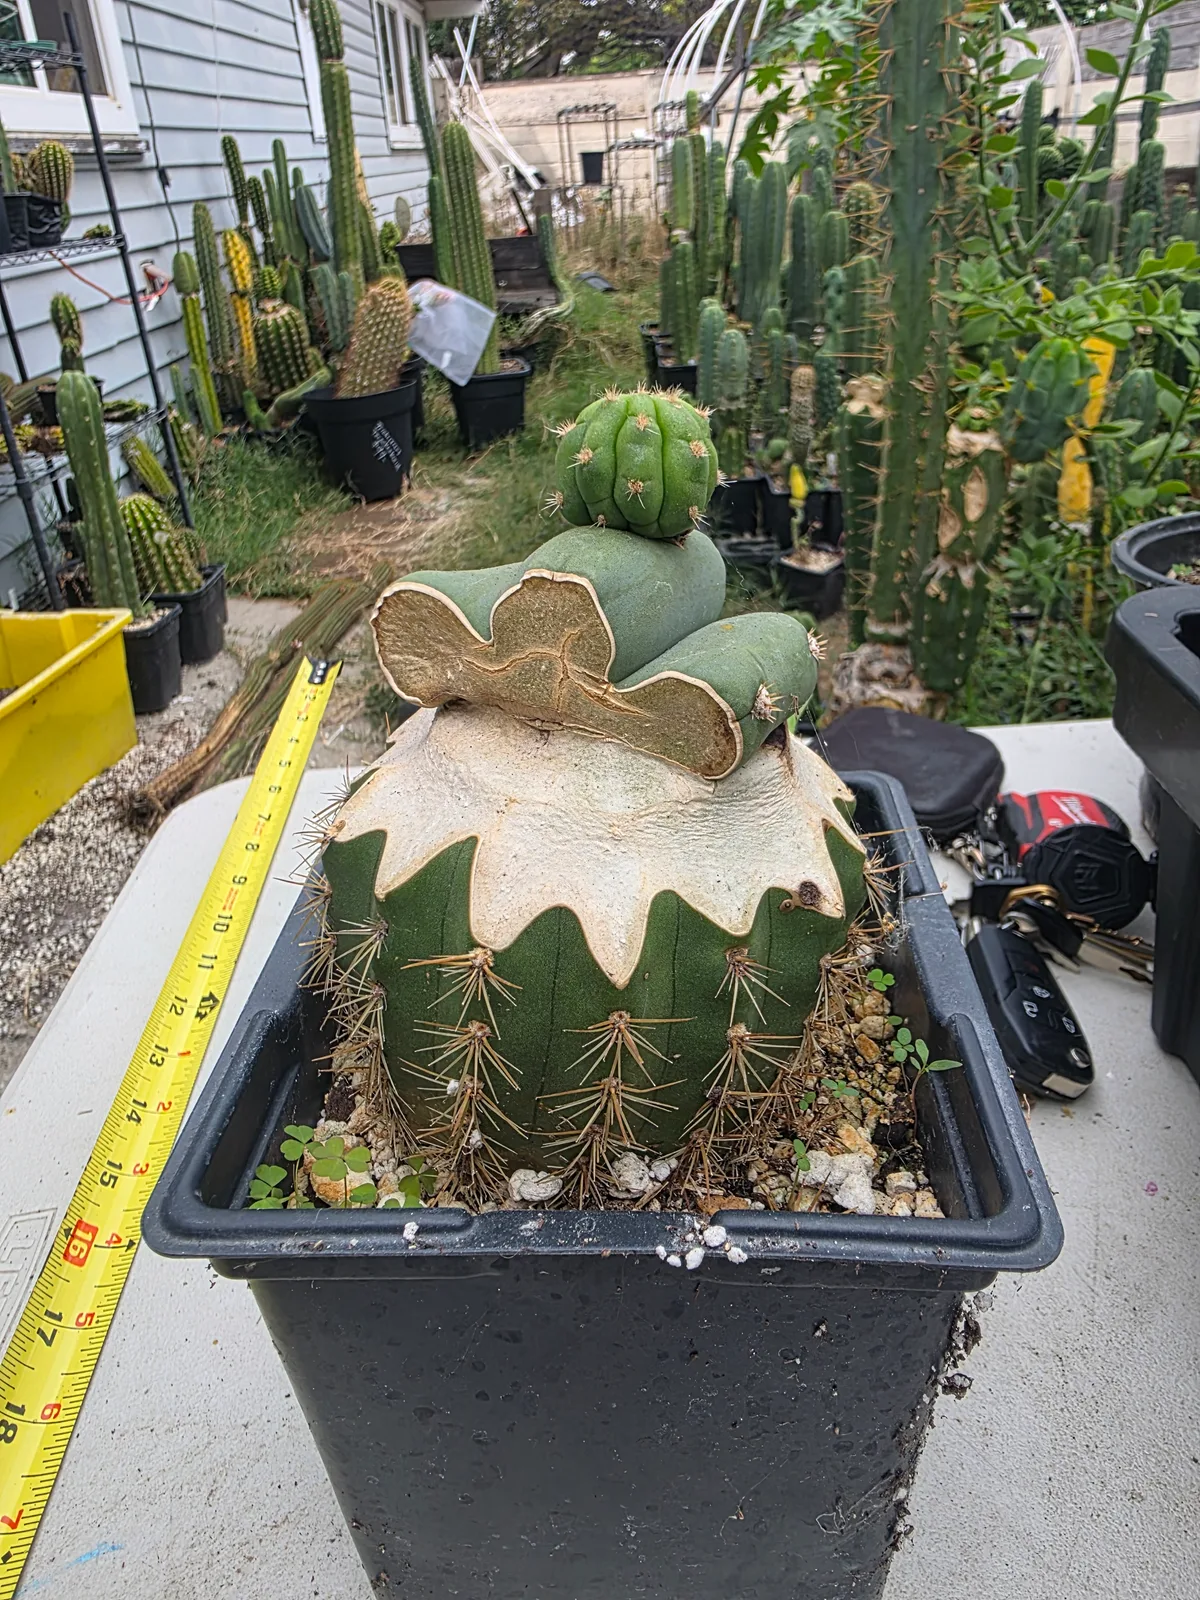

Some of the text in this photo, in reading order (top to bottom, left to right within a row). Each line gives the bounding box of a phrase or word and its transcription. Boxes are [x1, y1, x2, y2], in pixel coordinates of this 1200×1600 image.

[268, 785, 282, 793] 6
[258, 813, 272, 821] 7
[245, 842, 260, 852] 8
[232, 874, 247, 885] 9
[213, 914, 233, 933] 10
[198, 954, 218, 970] 11
[170, 995, 187, 1015] 12
[149, 1043, 169, 1068] 13
[126, 1098, 148, 1125] 14
[156, 1100, 172, 1112] 2
[99, 1159, 123, 1189] 15
[132, 1162, 149, 1176] 3
[69, 1227, 93, 1259] 16
[105, 1232, 123, 1247] 4
[36, 1308, 63, 1347] 17
[75, 1312, 96, 1327] 5
[41, 1403, 62, 1420] 6
[0, 1401, 26, 1444] 18
[1, 1509, 24, 1529] 7
